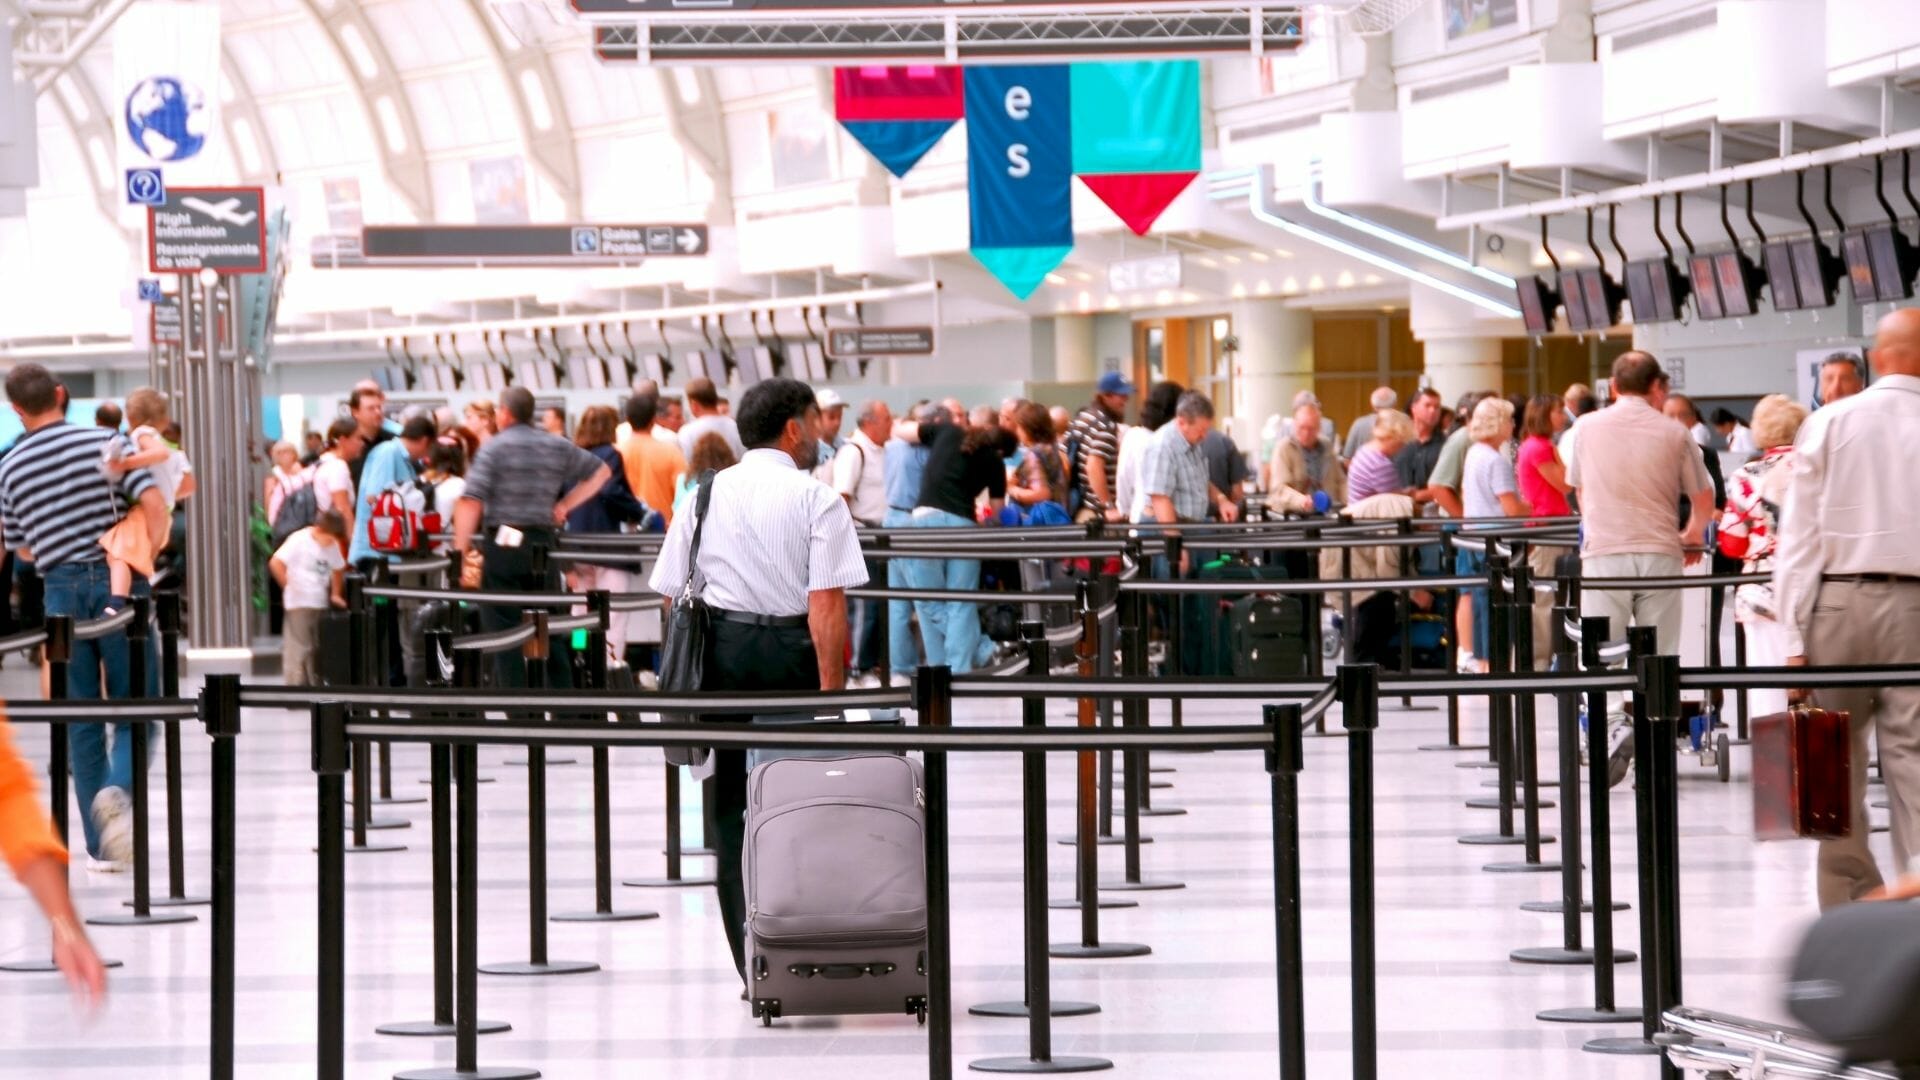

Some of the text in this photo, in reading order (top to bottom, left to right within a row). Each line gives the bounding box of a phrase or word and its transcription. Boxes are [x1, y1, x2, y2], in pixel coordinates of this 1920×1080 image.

[155, 212, 191, 228] Flight
[155, 225, 227, 238] Information
[602, 227, 640, 240] Gates
[156, 242, 259, 259] Renseignements
[602, 241, 646, 254] Portes
[157, 256, 173, 268] de
